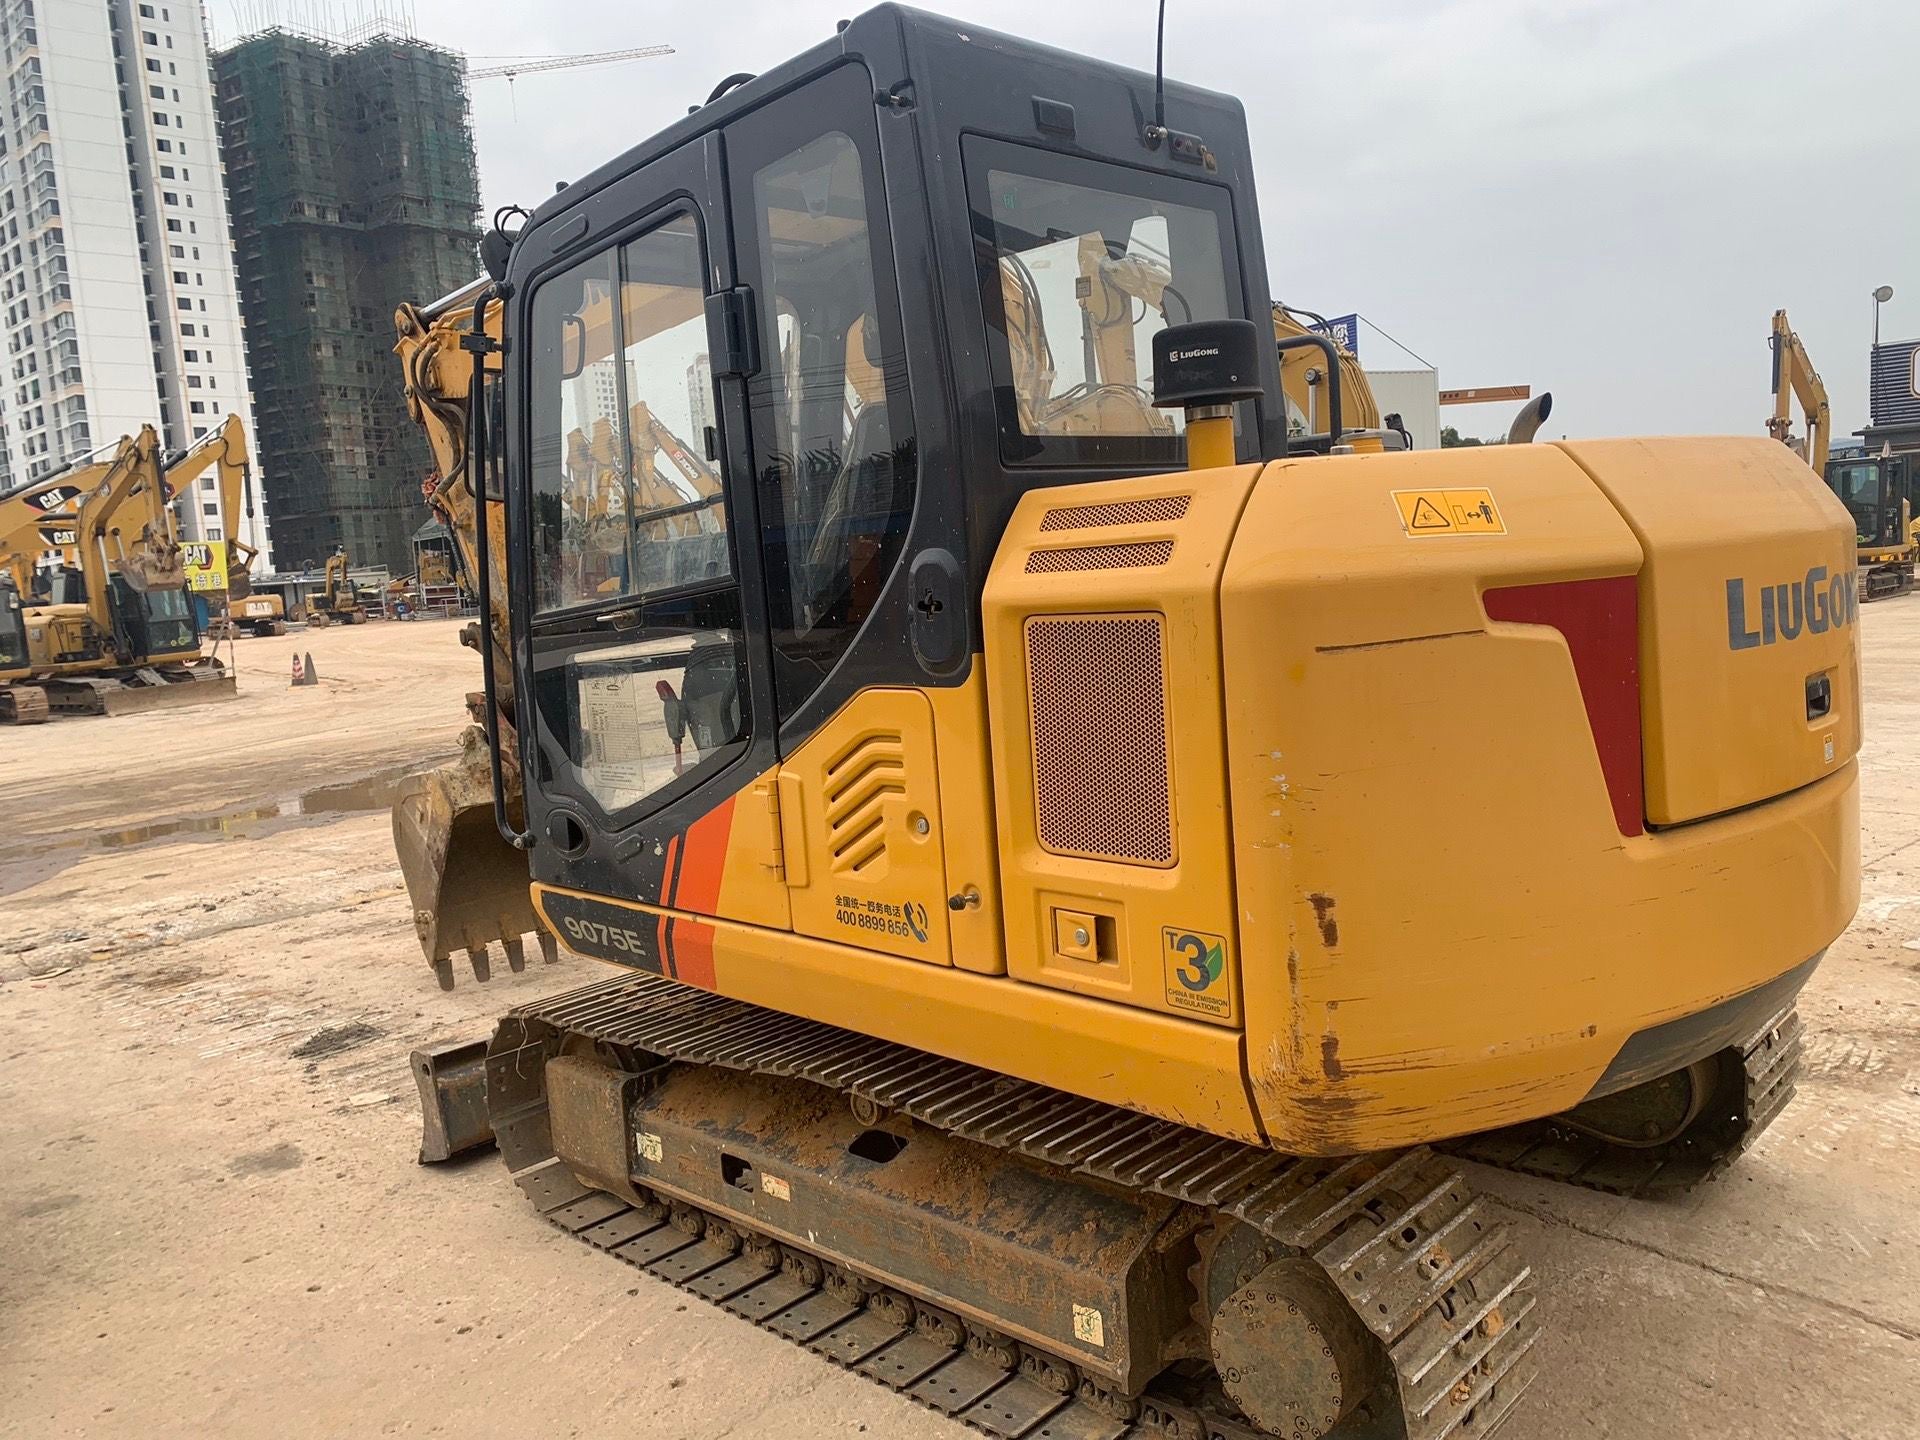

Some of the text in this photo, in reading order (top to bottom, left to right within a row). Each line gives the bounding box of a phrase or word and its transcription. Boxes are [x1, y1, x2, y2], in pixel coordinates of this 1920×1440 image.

[39, 488, 64, 509] CAT
[53, 531, 75, 544] CAT
[184, 545, 207, 565] CAT
[836, 909, 909, 937] 400 8899 856
[563, 916, 646, 956] 9075E
[1168, 988, 1188, 999] CHINA
[1196, 994, 1228, 1007] EMISSION
[1175, 997, 1221, 1012] REGULATIONS
